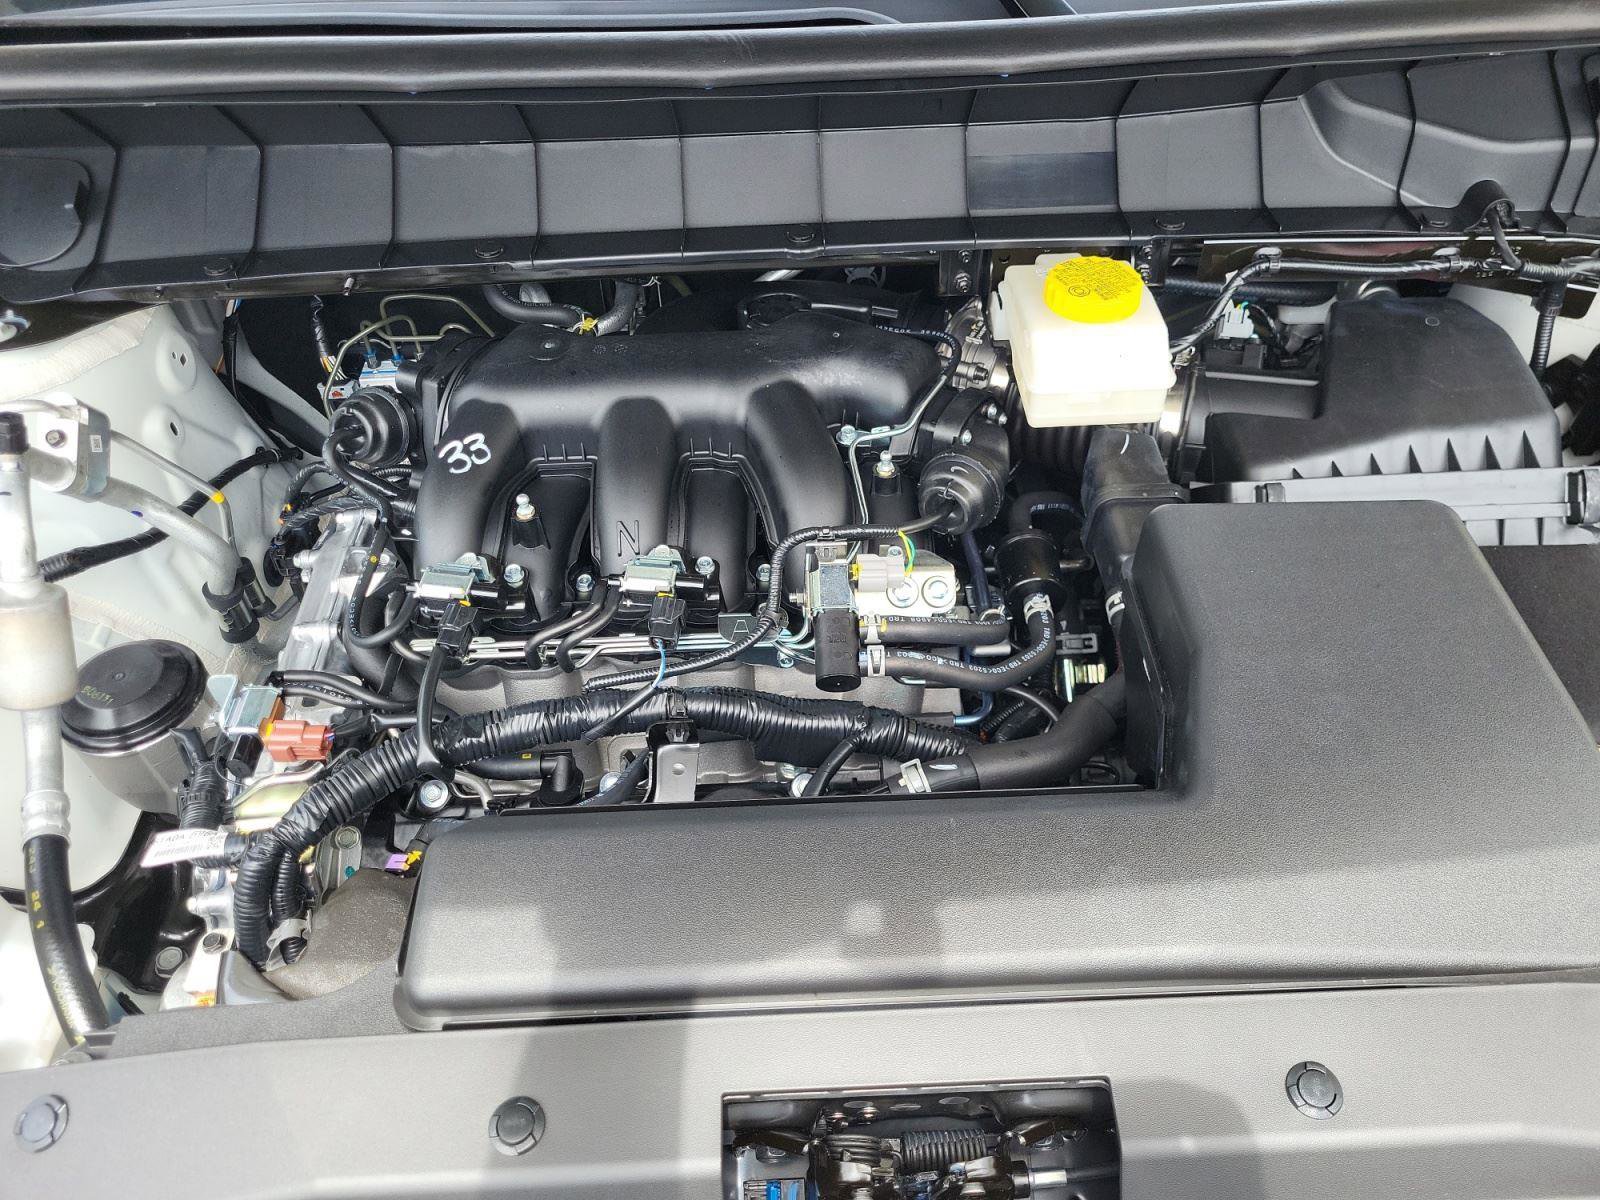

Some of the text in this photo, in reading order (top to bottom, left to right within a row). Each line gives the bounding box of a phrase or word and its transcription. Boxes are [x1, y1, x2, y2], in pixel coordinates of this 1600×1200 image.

[438, 432, 492, 474] 33
[615, 519, 641, 557] N
[730, 619, 750, 641] A
